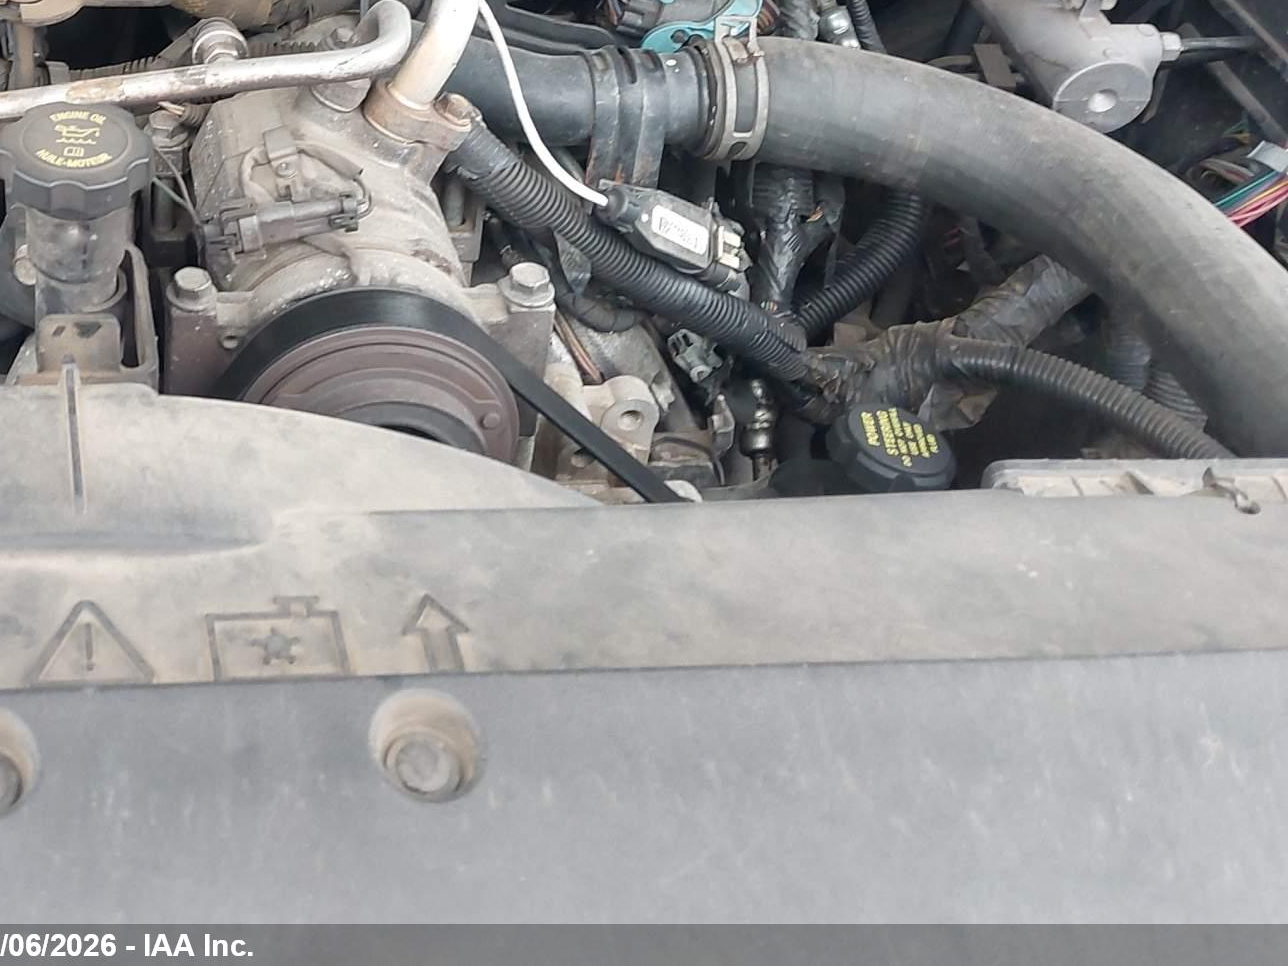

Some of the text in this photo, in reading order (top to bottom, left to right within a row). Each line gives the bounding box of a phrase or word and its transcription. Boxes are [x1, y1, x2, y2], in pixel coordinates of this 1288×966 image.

[49, 111, 107, 125] ENGINE OIL
[35, 148, 114, 168] HUILE-MOTEUR
